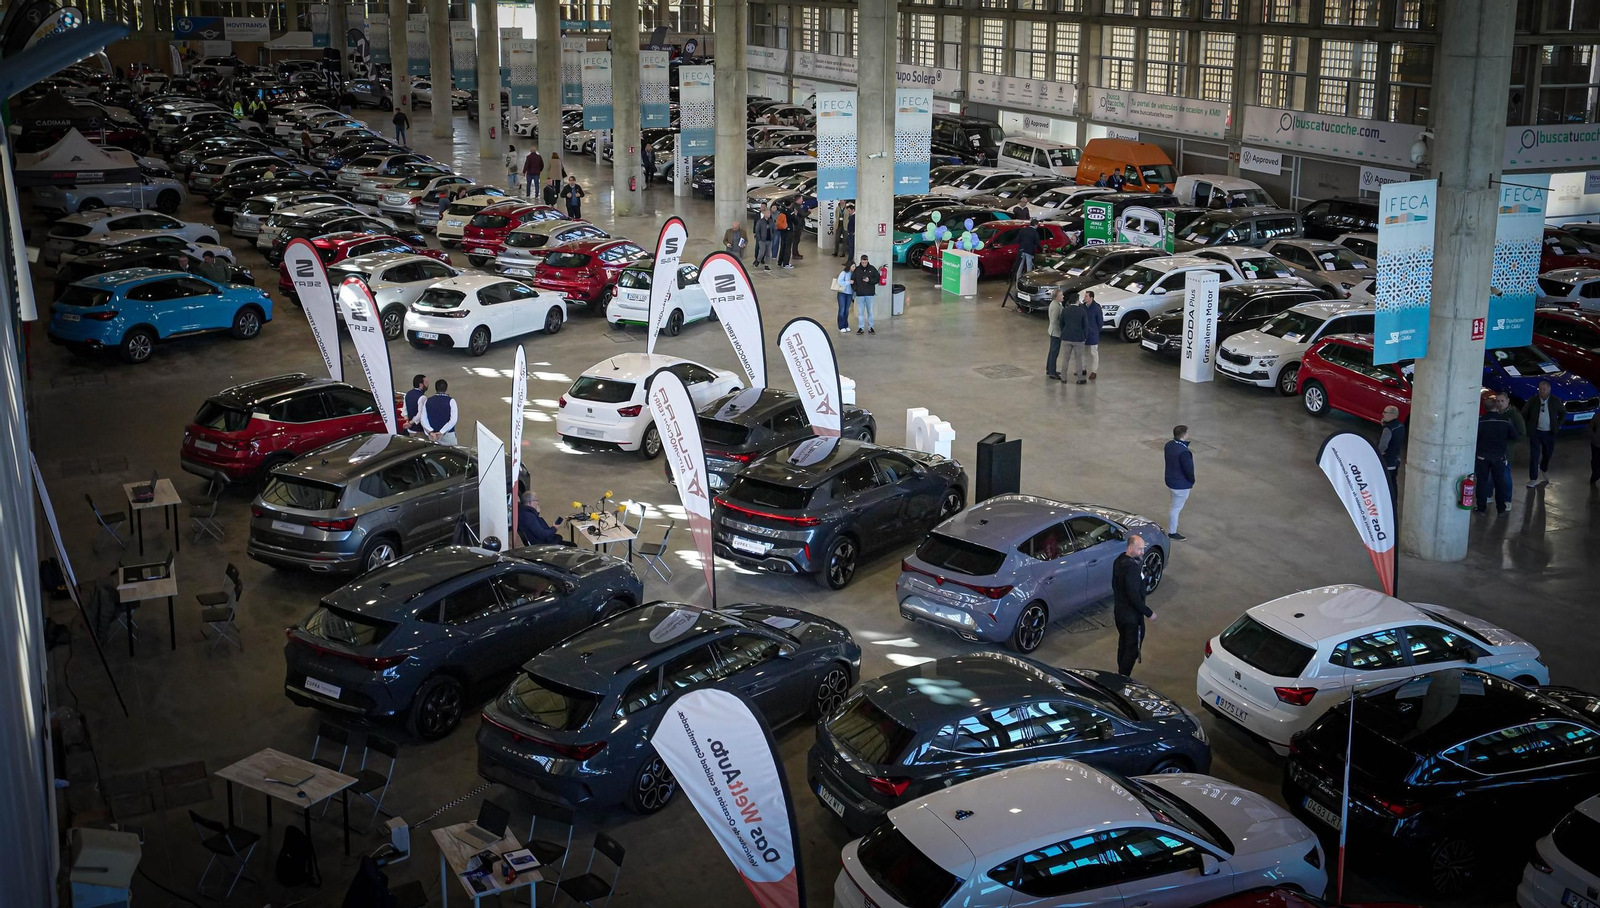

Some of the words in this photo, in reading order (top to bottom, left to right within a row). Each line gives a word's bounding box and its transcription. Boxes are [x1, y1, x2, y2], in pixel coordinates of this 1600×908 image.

[896, 71, 911, 83] rupo
[912, 71, 936, 84] Solera
[820, 100, 853, 110] IFECA
[898, 96, 930, 106] IFECA
[1137, 100, 1150, 108] portal
[35, 119, 71, 127] CADIMAR
[1031, 119, 1049, 129] Approved
[1251, 154, 1279, 166] Approved
[1499, 186, 1543, 203] IFECA
[1385, 195, 1430, 212] IFECA
[1203, 318, 1211, 364] Grazalema
[734, 540, 748, 548] CUPRA
[306, 680, 321, 689] CUPRA
[1220, 697, 1235, 712] 9175
[1235, 705, 1249, 721] LKT
[502, 746, 530, 760] CUPRA
[1307, 798, 1327, 819] 0493
[1326, 811, 1342, 831] LRT
